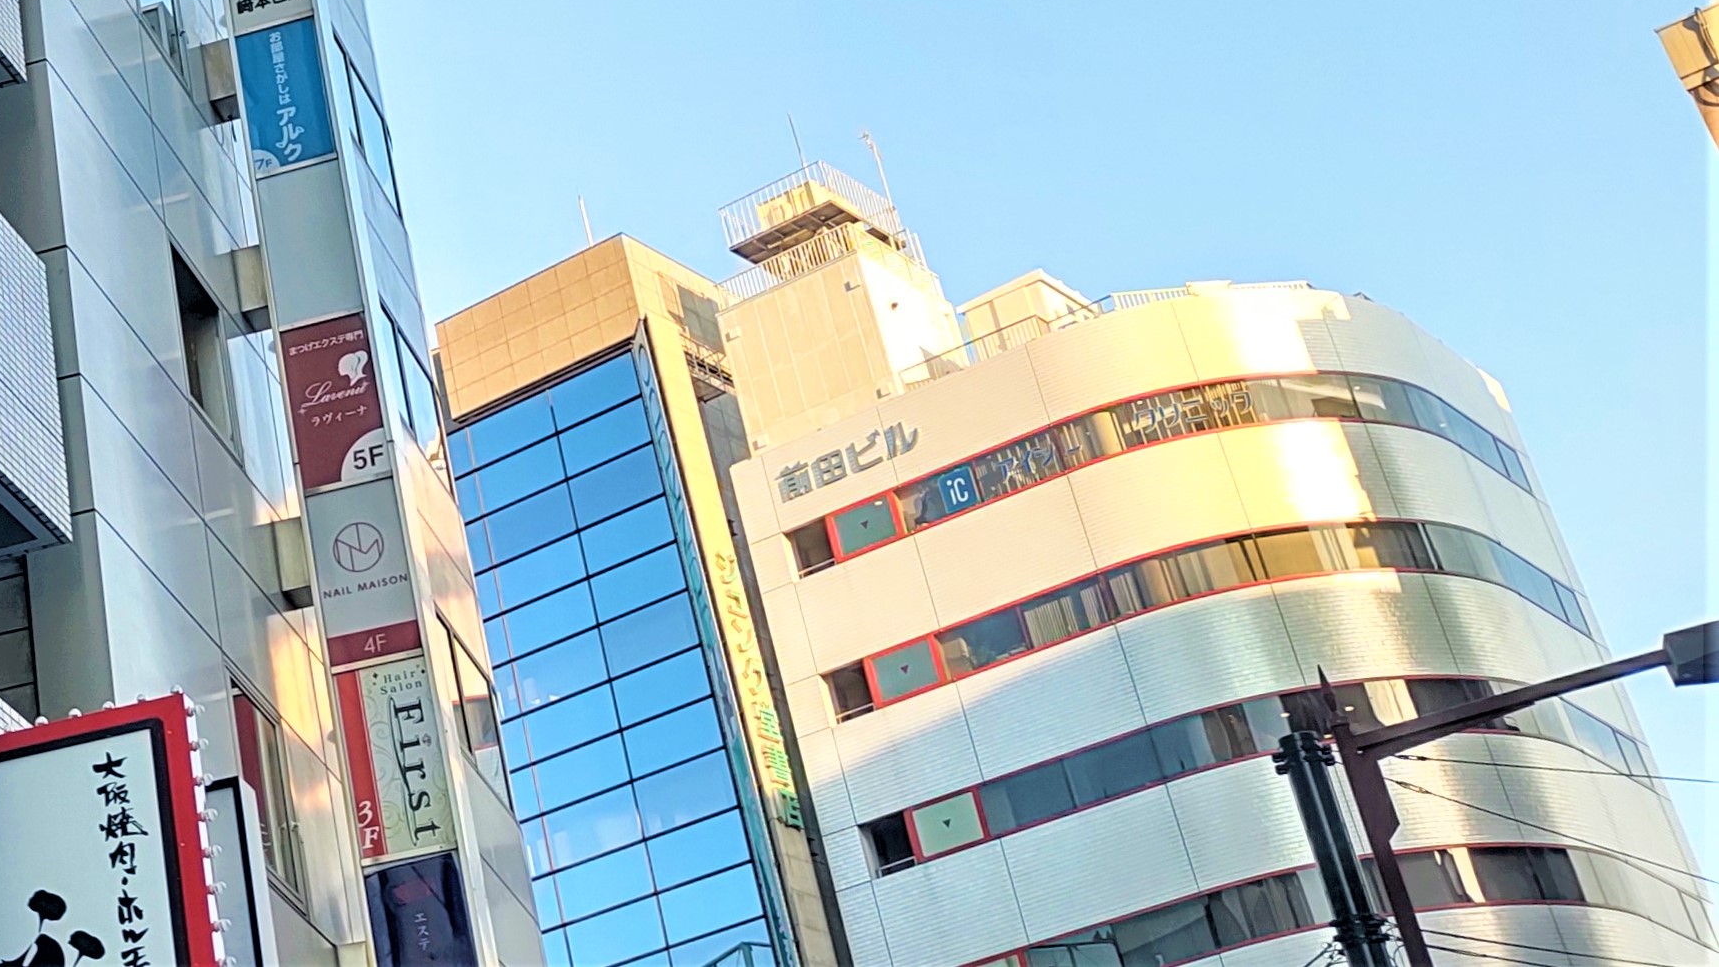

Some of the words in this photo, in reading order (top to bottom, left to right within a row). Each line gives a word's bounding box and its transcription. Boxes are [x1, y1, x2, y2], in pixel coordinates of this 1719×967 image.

[255, 157, 273, 171] 7F
[353, 444, 385, 470] 5F
[774, 420, 920, 504] 前田ビル
[323, 586, 353, 600] NAIL
[357, 573, 409, 593] MAISON
[363, 633, 388, 654] 4F
[380, 679, 423, 695] Salon
[383, 669, 417, 684] Hair
[391, 697, 442, 844] First
[414, 912, 430, 951] エステ
